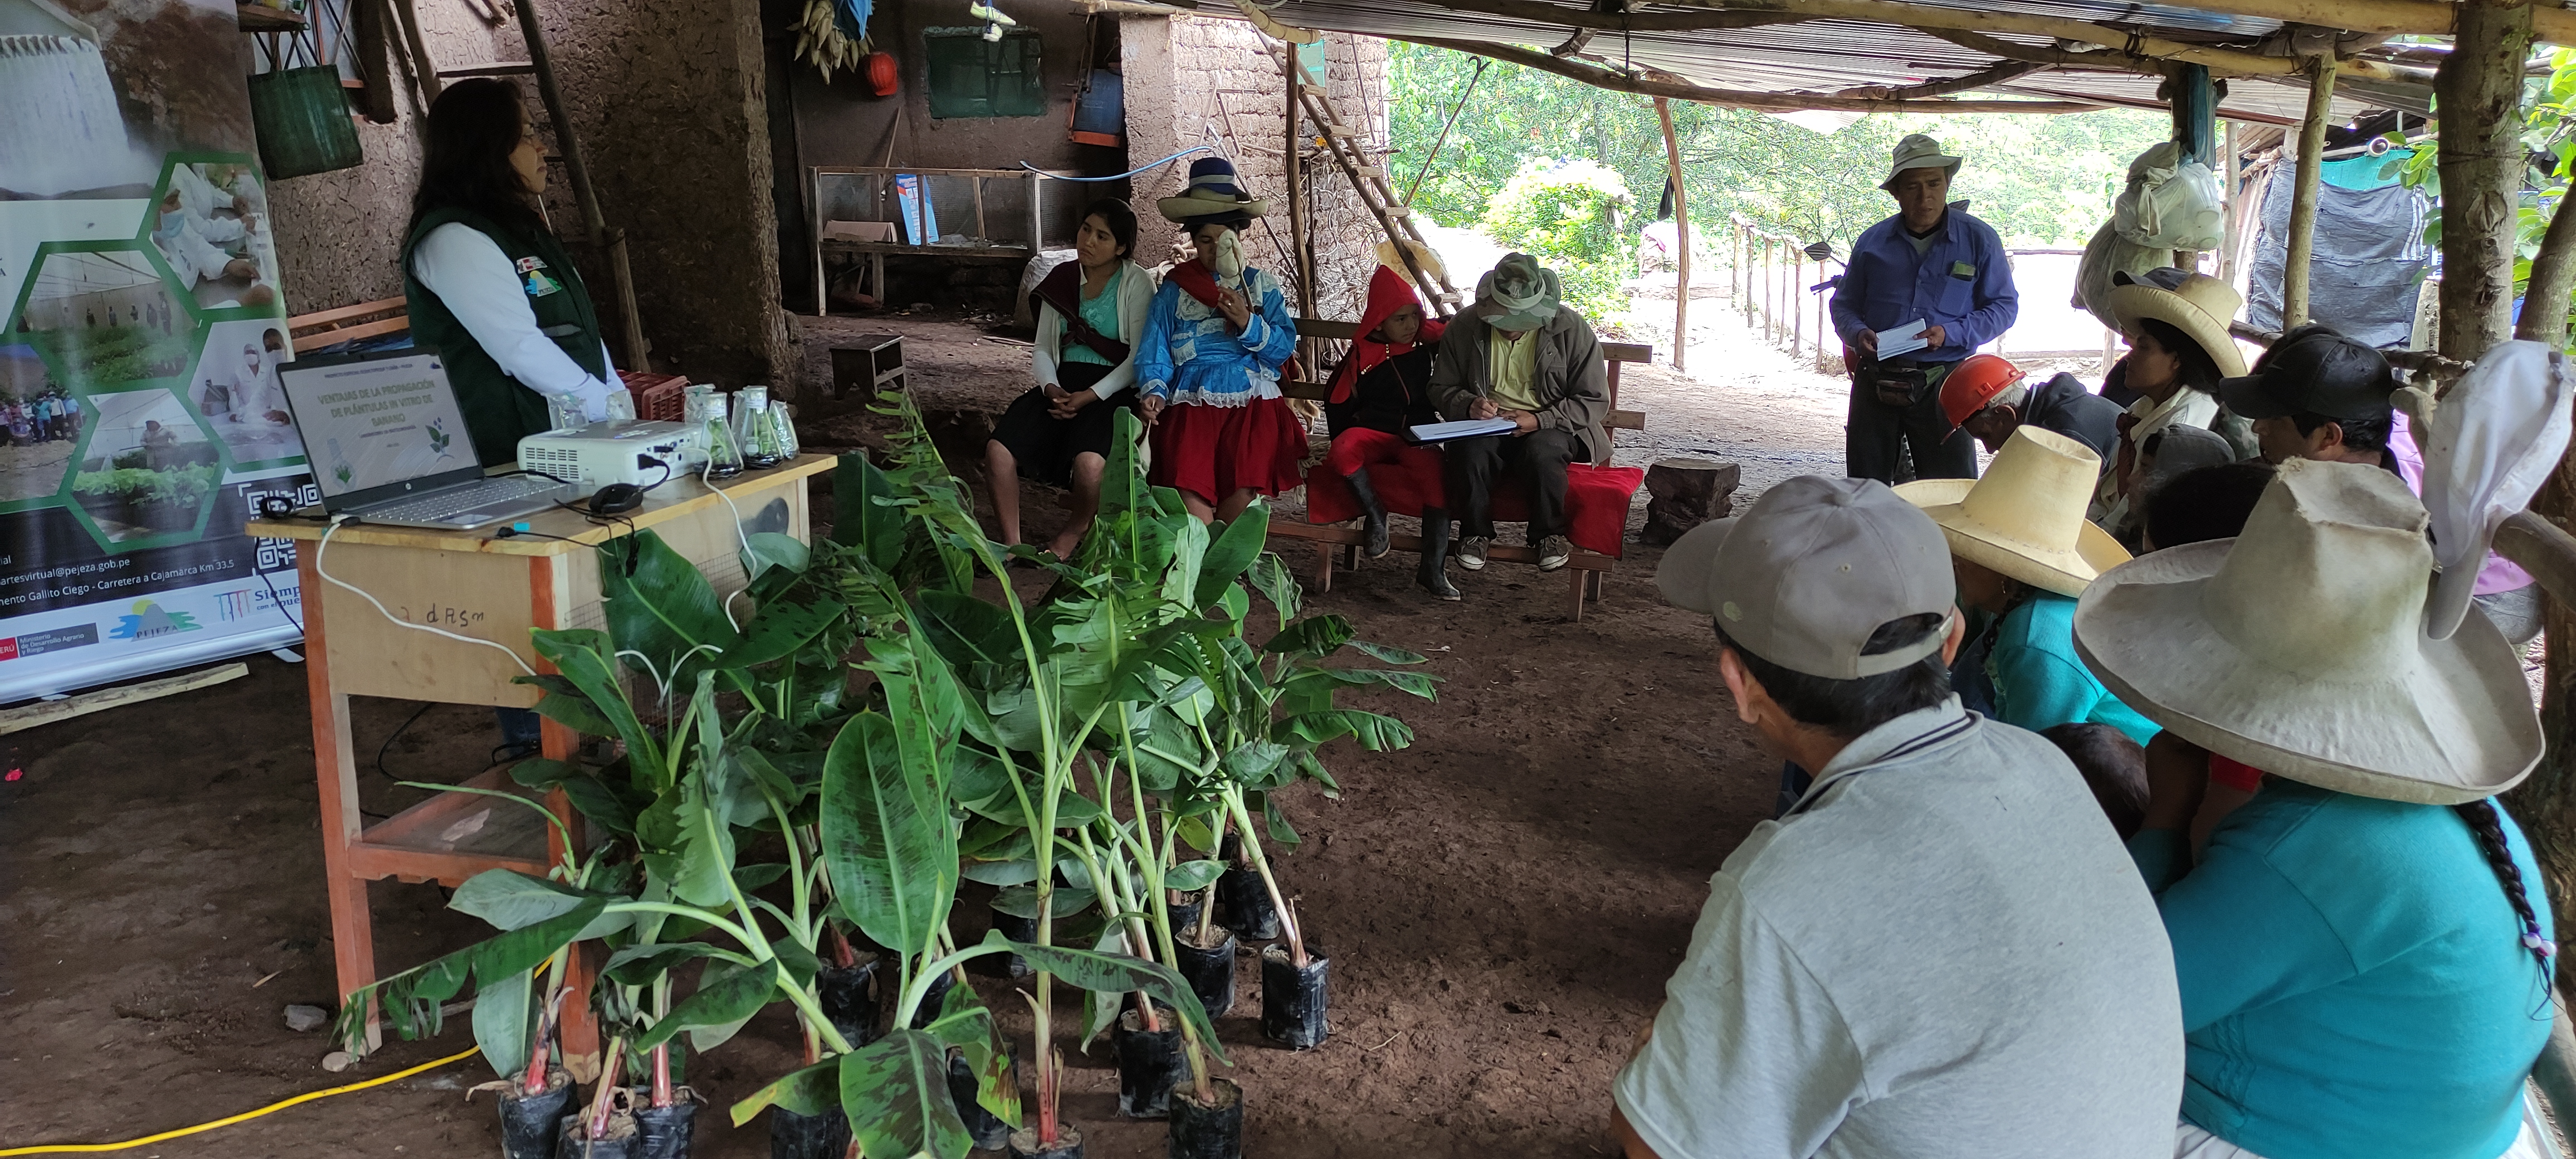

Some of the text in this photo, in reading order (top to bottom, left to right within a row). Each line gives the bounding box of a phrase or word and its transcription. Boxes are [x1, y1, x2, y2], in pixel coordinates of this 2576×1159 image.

[318, 378, 435, 405] VENTAJAS DE LA PROPAGACIÓN
[330, 408, 343, 418] DE
[344, 401, 388, 416] PLÁNTULAS
[398, 396, 422, 407] VITRO
[422, 394, 433, 403] DE
[371, 413, 406, 427] BANANO
[28, 588, 60, 601] Gallito
[62, 585, 90, 595] Ciego
[97, 576, 142, 590] Carretera
[151, 567, 197, 582] Cajamarca
[199, 564, 214, 573] Km
[216, 559, 235, 570] 33.5
[19, 634, 51, 644] Ministerio
[30, 637, 61, 647] Desarrollo
[62, 632, 84, 642] Agrario
